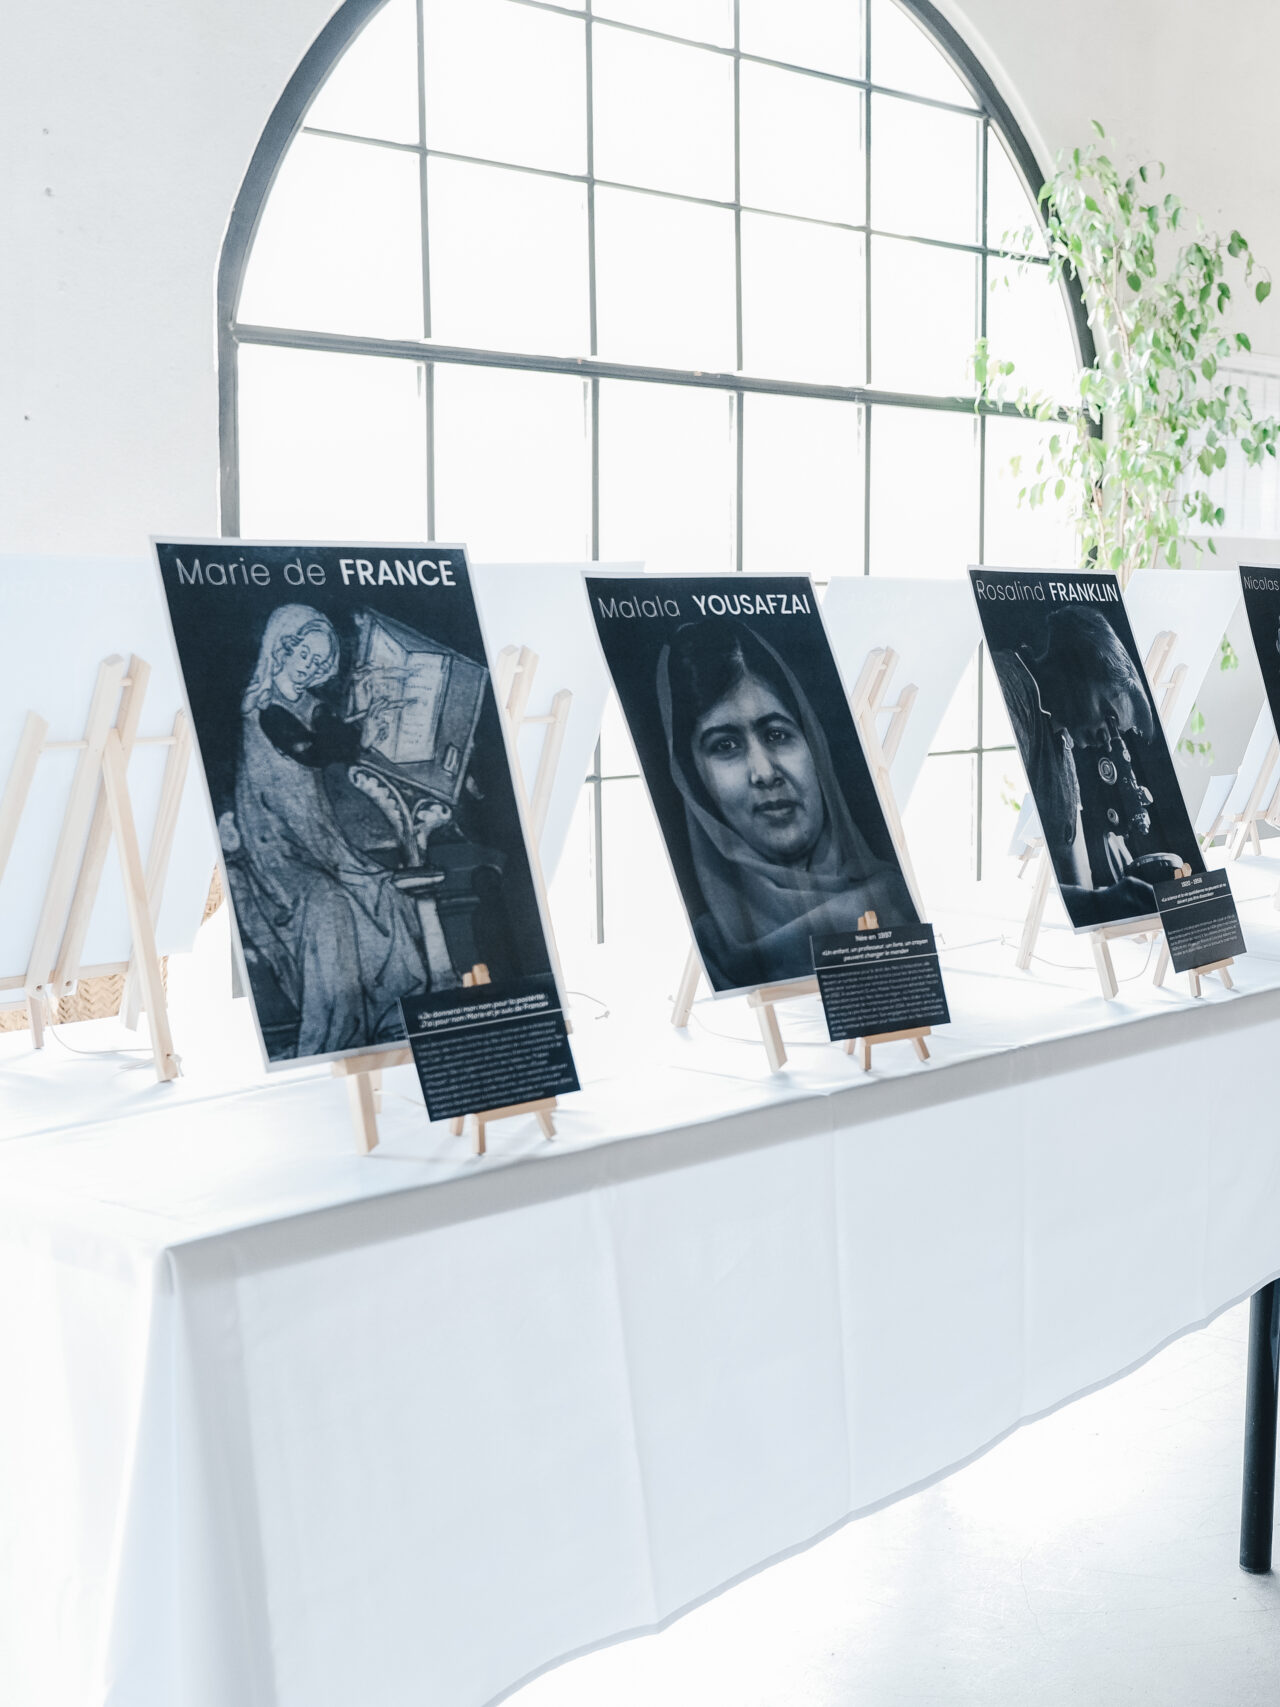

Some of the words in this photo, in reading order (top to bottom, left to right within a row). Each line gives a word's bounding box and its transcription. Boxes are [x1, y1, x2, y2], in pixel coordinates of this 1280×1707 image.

[176, 557, 271, 586] Marie
[284, 559, 327, 586] de
[339, 559, 457, 587] FRANCE
[1243, 576, 1280, 591] Nicolas
[975, 580, 1046, 601] Rosalind
[1049, 582, 1119, 602] FRANKLIN
[598, 595, 681, 618] Malala
[692, 594, 812, 616] YOUSAFZAI
